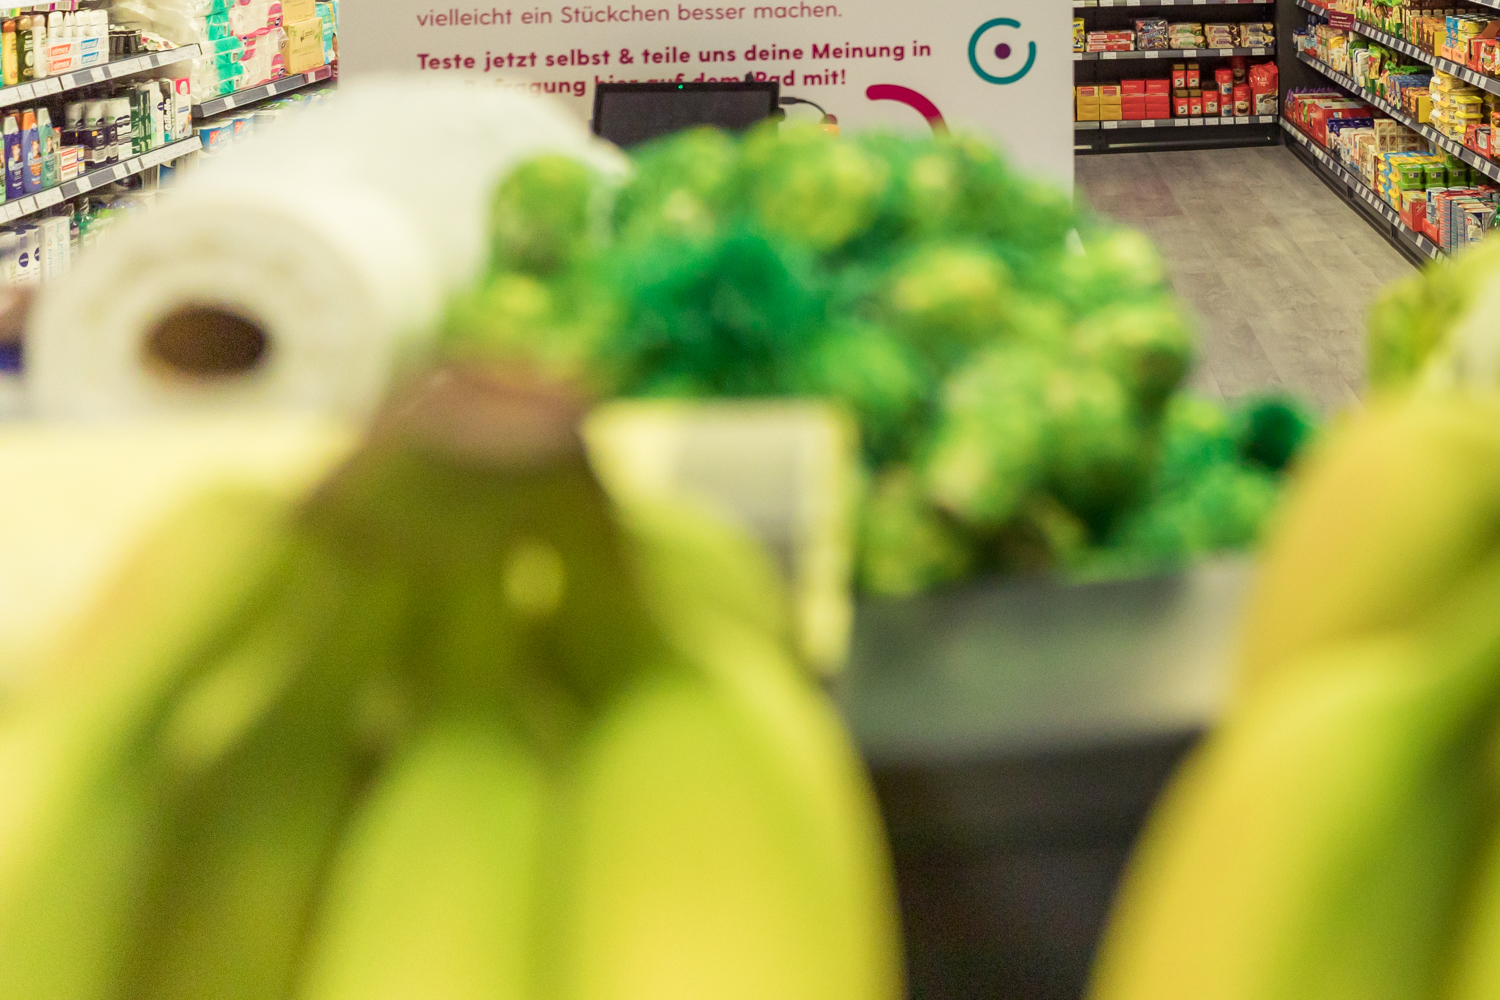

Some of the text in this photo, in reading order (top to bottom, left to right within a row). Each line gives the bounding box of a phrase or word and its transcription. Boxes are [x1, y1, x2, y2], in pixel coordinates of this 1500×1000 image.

[416, 0, 843, 27] vielleicht ein Stückchen besser machen.
[52, 45, 70, 55] elmex
[417, 39, 931, 72] Teste jetzt selbst & teile uns deine Meinung in
[53, 60, 70, 70] elmex
[803, 69, 847, 86] mit!
